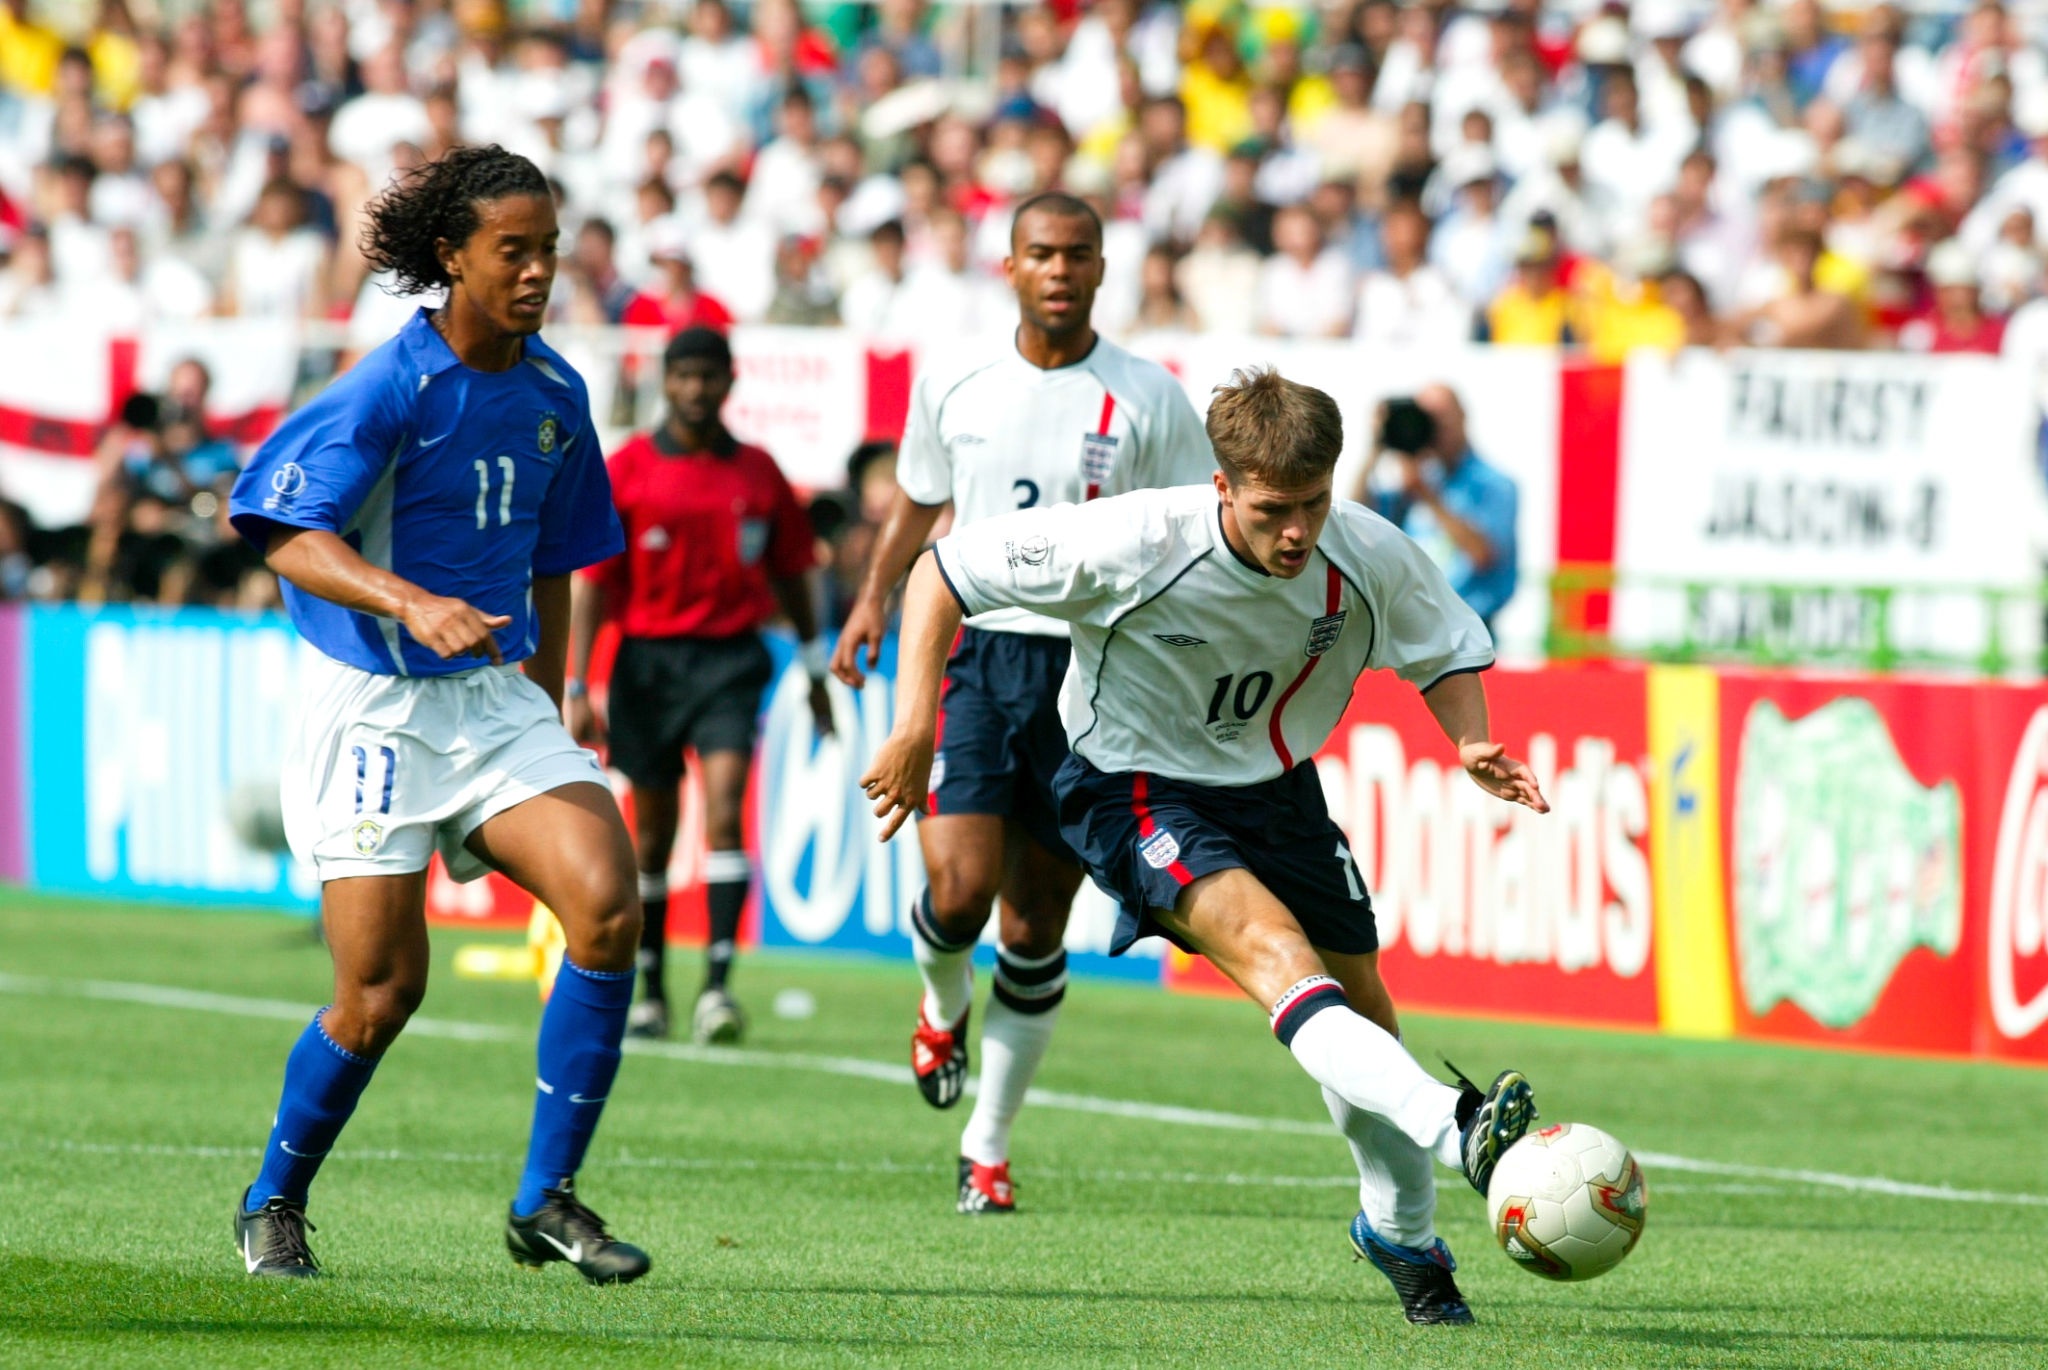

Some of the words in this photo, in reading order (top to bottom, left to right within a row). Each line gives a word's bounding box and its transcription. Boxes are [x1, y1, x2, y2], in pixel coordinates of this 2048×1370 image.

[474, 456, 515, 530] 11
[1206, 670, 1274, 726] 10
[351, 745, 396, 815] 11
[1334, 840, 1371, 911] 1
